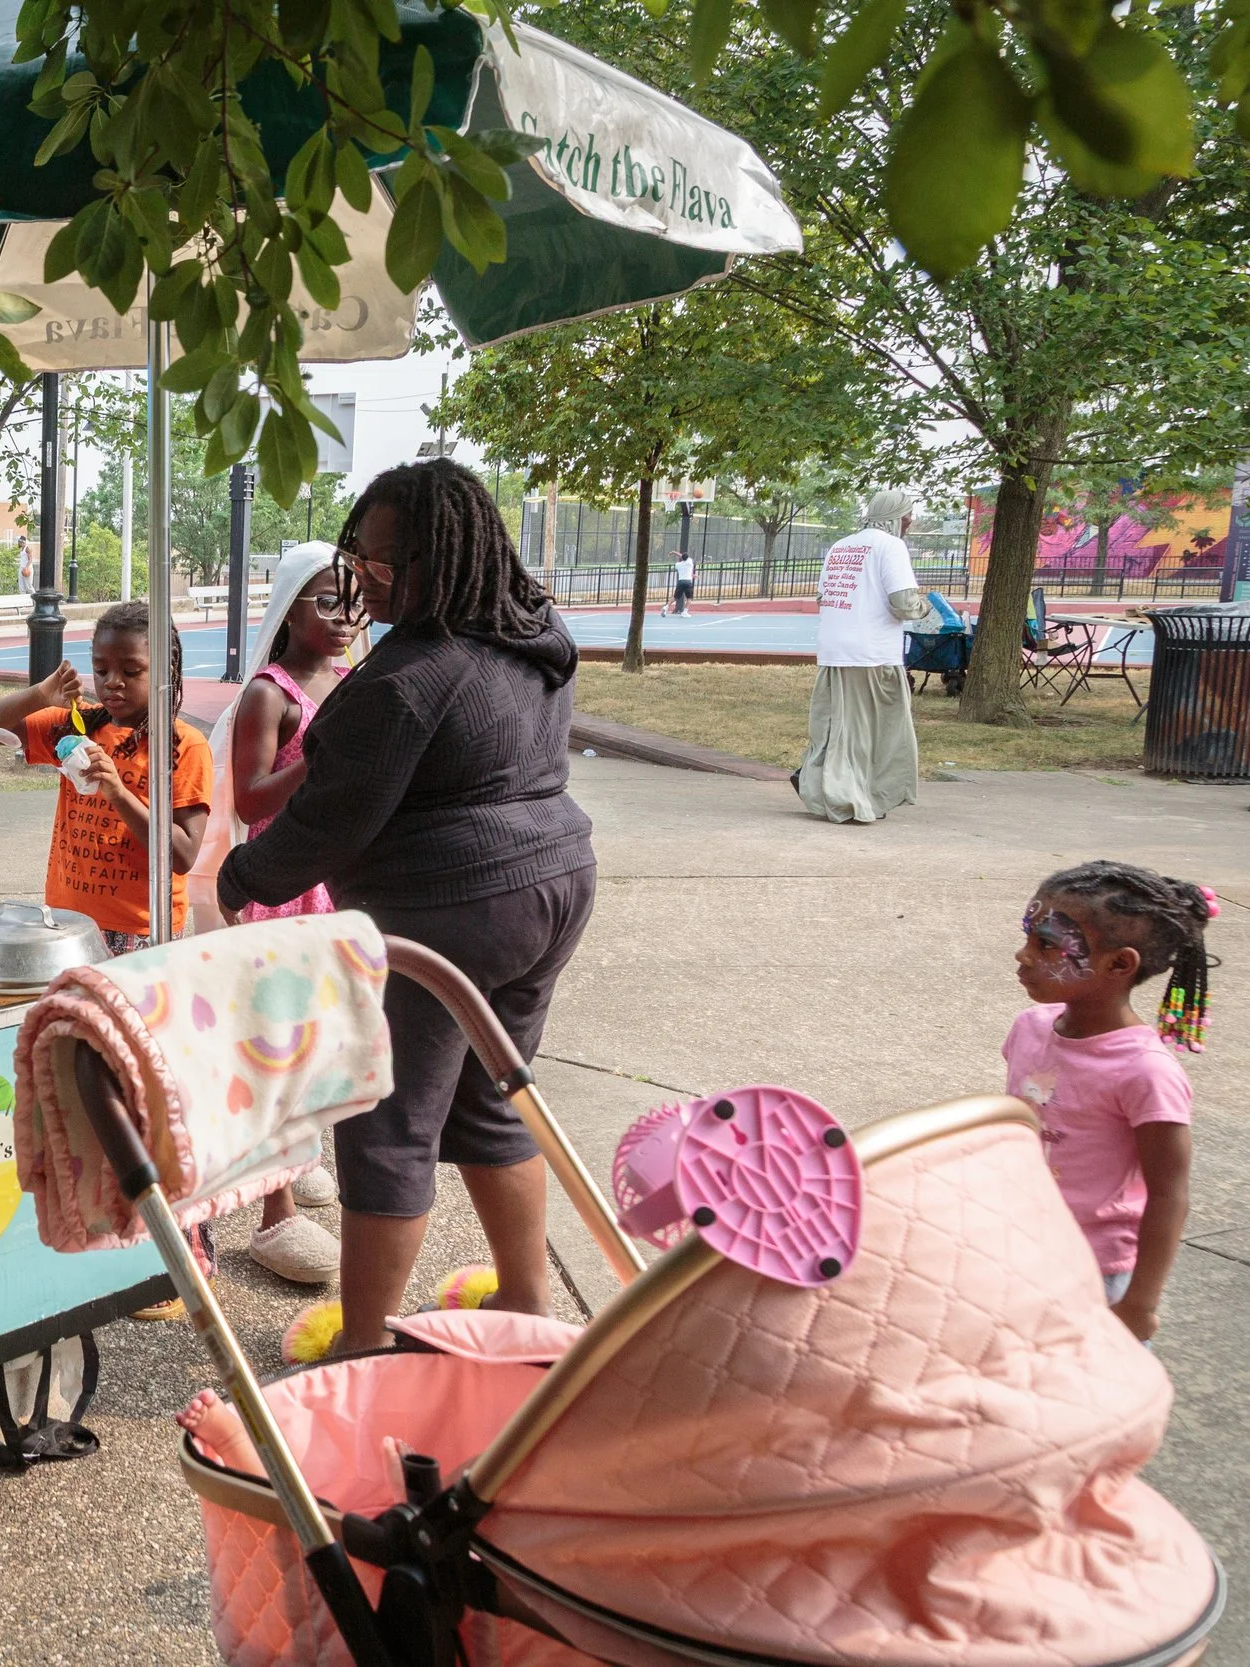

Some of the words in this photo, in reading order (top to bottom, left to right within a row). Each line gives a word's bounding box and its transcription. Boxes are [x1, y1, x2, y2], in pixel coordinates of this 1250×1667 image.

[611, 145, 665, 203] the
[669, 156, 737, 230] Flava
[68, 809, 123, 829] CHRIST
[71, 827, 135, 853] SPEECH,
[90, 867, 139, 883] FAITH
[65, 877, 119, 897] PURITY
